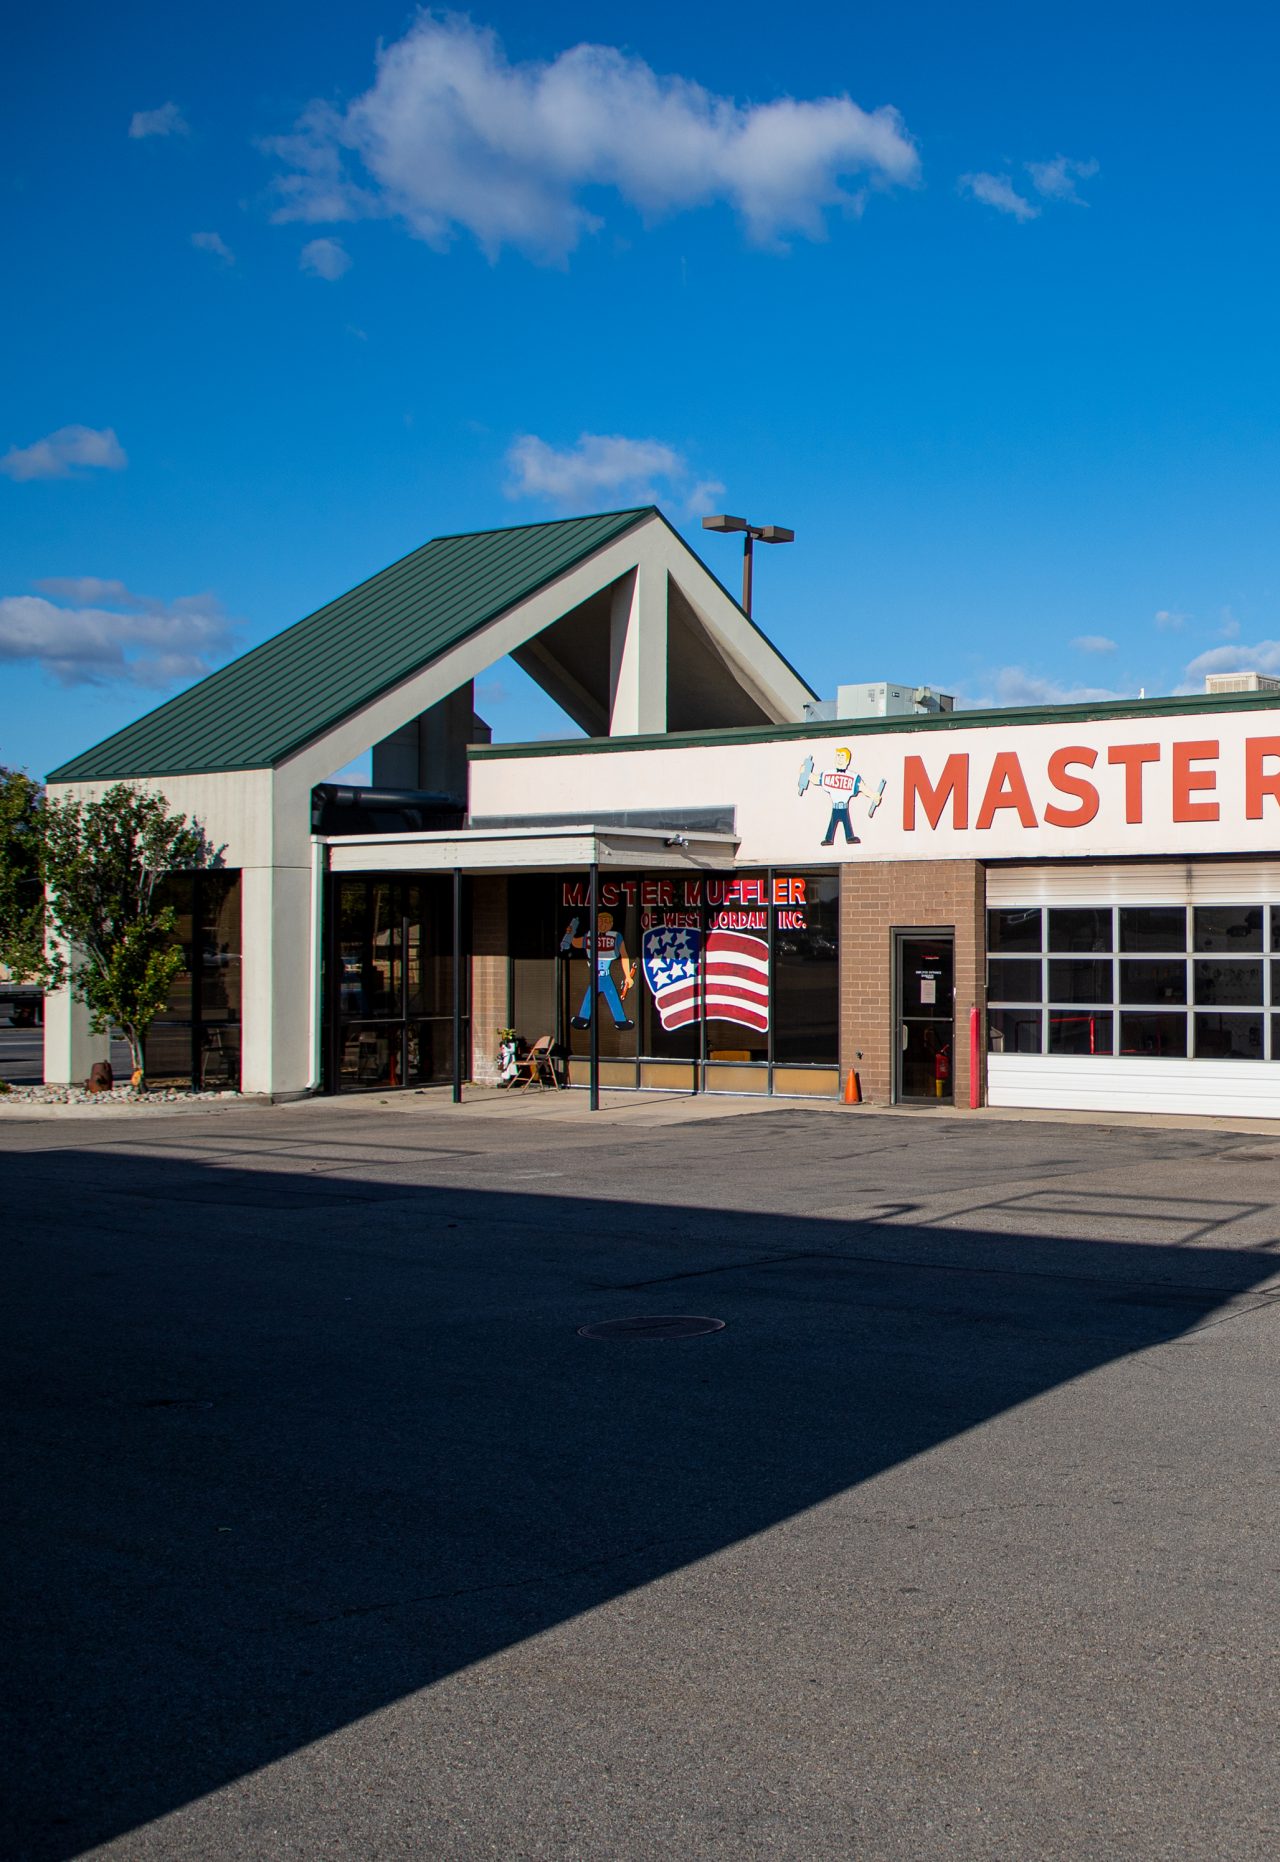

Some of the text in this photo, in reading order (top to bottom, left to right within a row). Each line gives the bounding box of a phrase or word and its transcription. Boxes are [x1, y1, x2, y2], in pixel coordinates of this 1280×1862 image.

[824, 775, 854, 789] MASTER
[684, 878, 807, 906] MUFFLER
[641, 911, 807, 930] OF WEST JORDAN INC.
